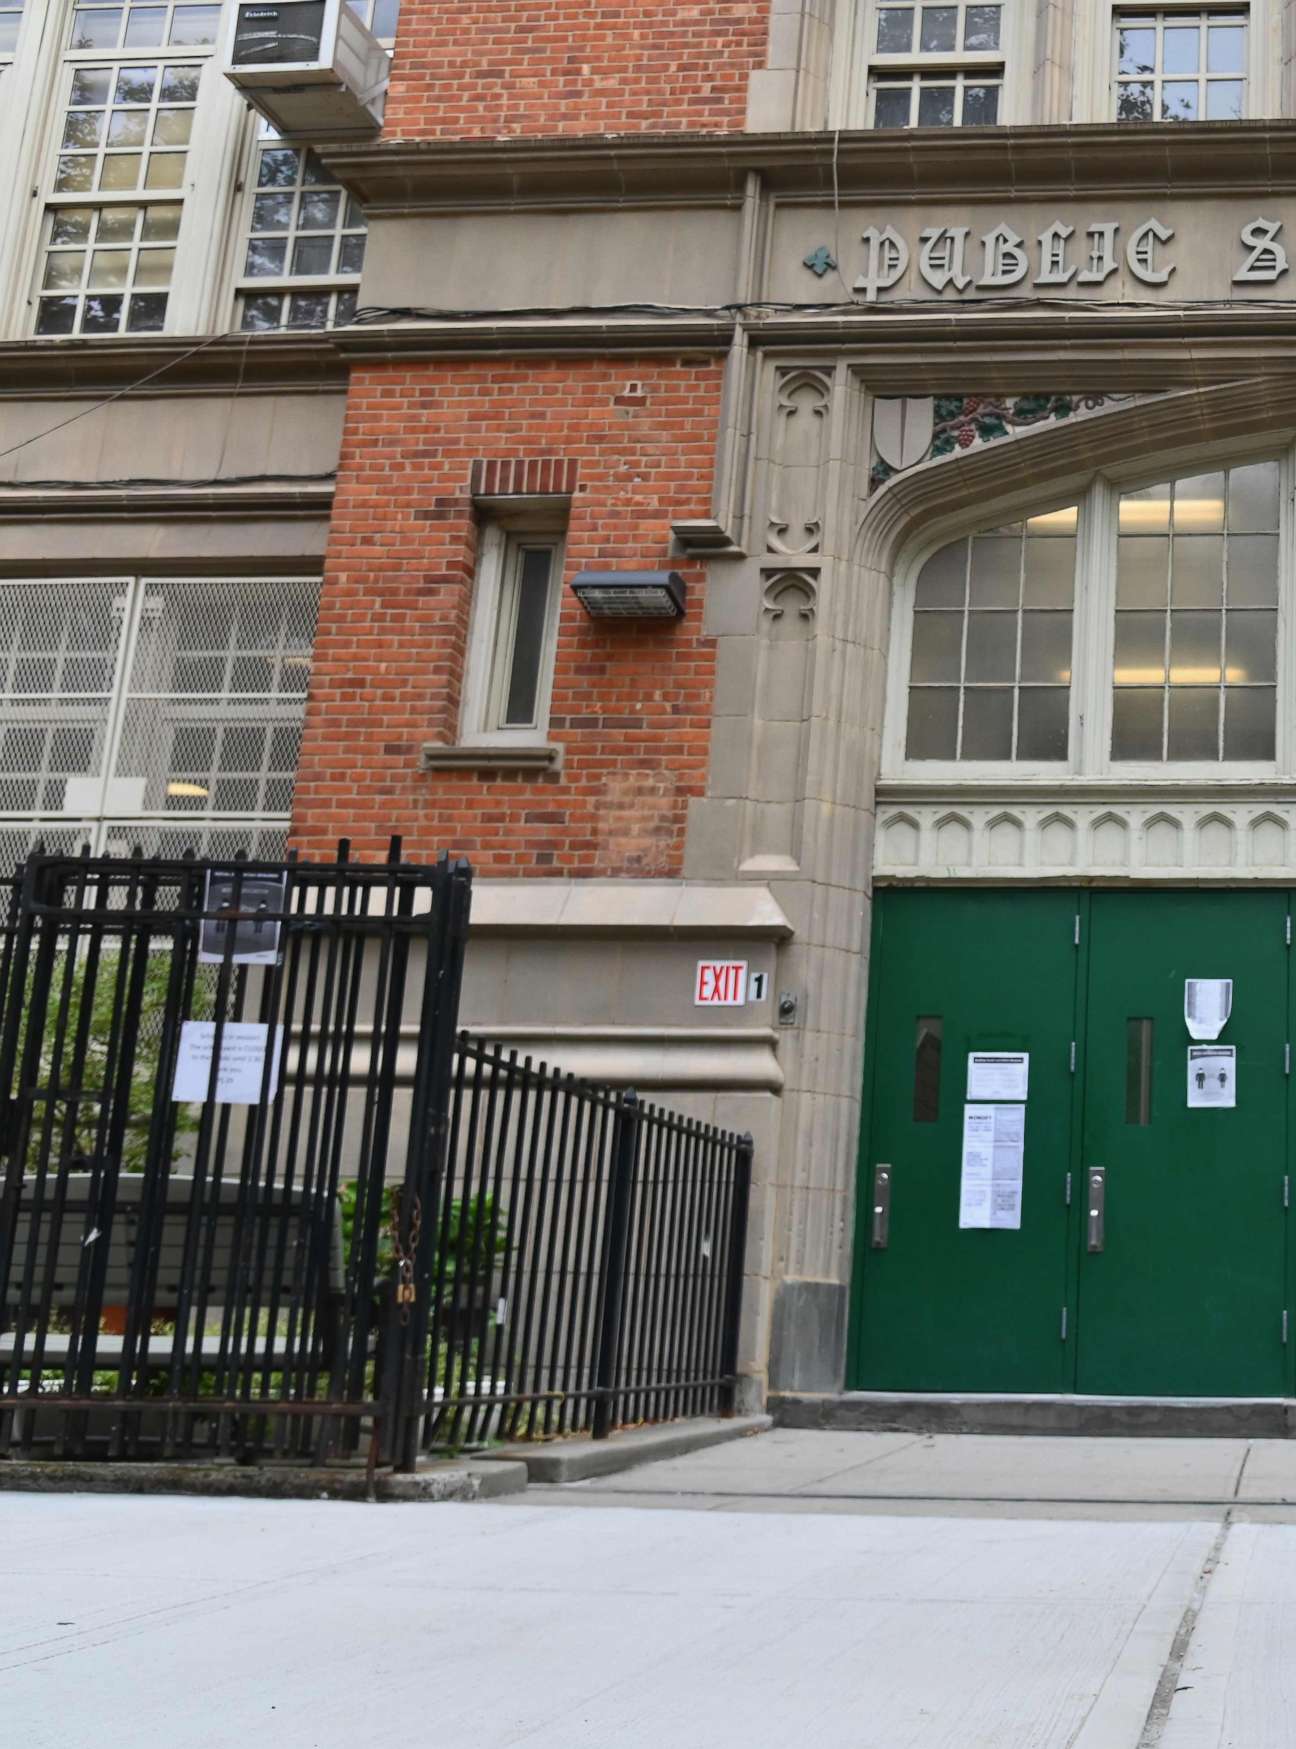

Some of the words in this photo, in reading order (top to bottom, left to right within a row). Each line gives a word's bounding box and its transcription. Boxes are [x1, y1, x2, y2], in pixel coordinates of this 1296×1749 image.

[853, 217, 1176, 301] PUBLIC
[698, 965, 743, 1001] EXIT
[754, 973, 764, 1000] 1
